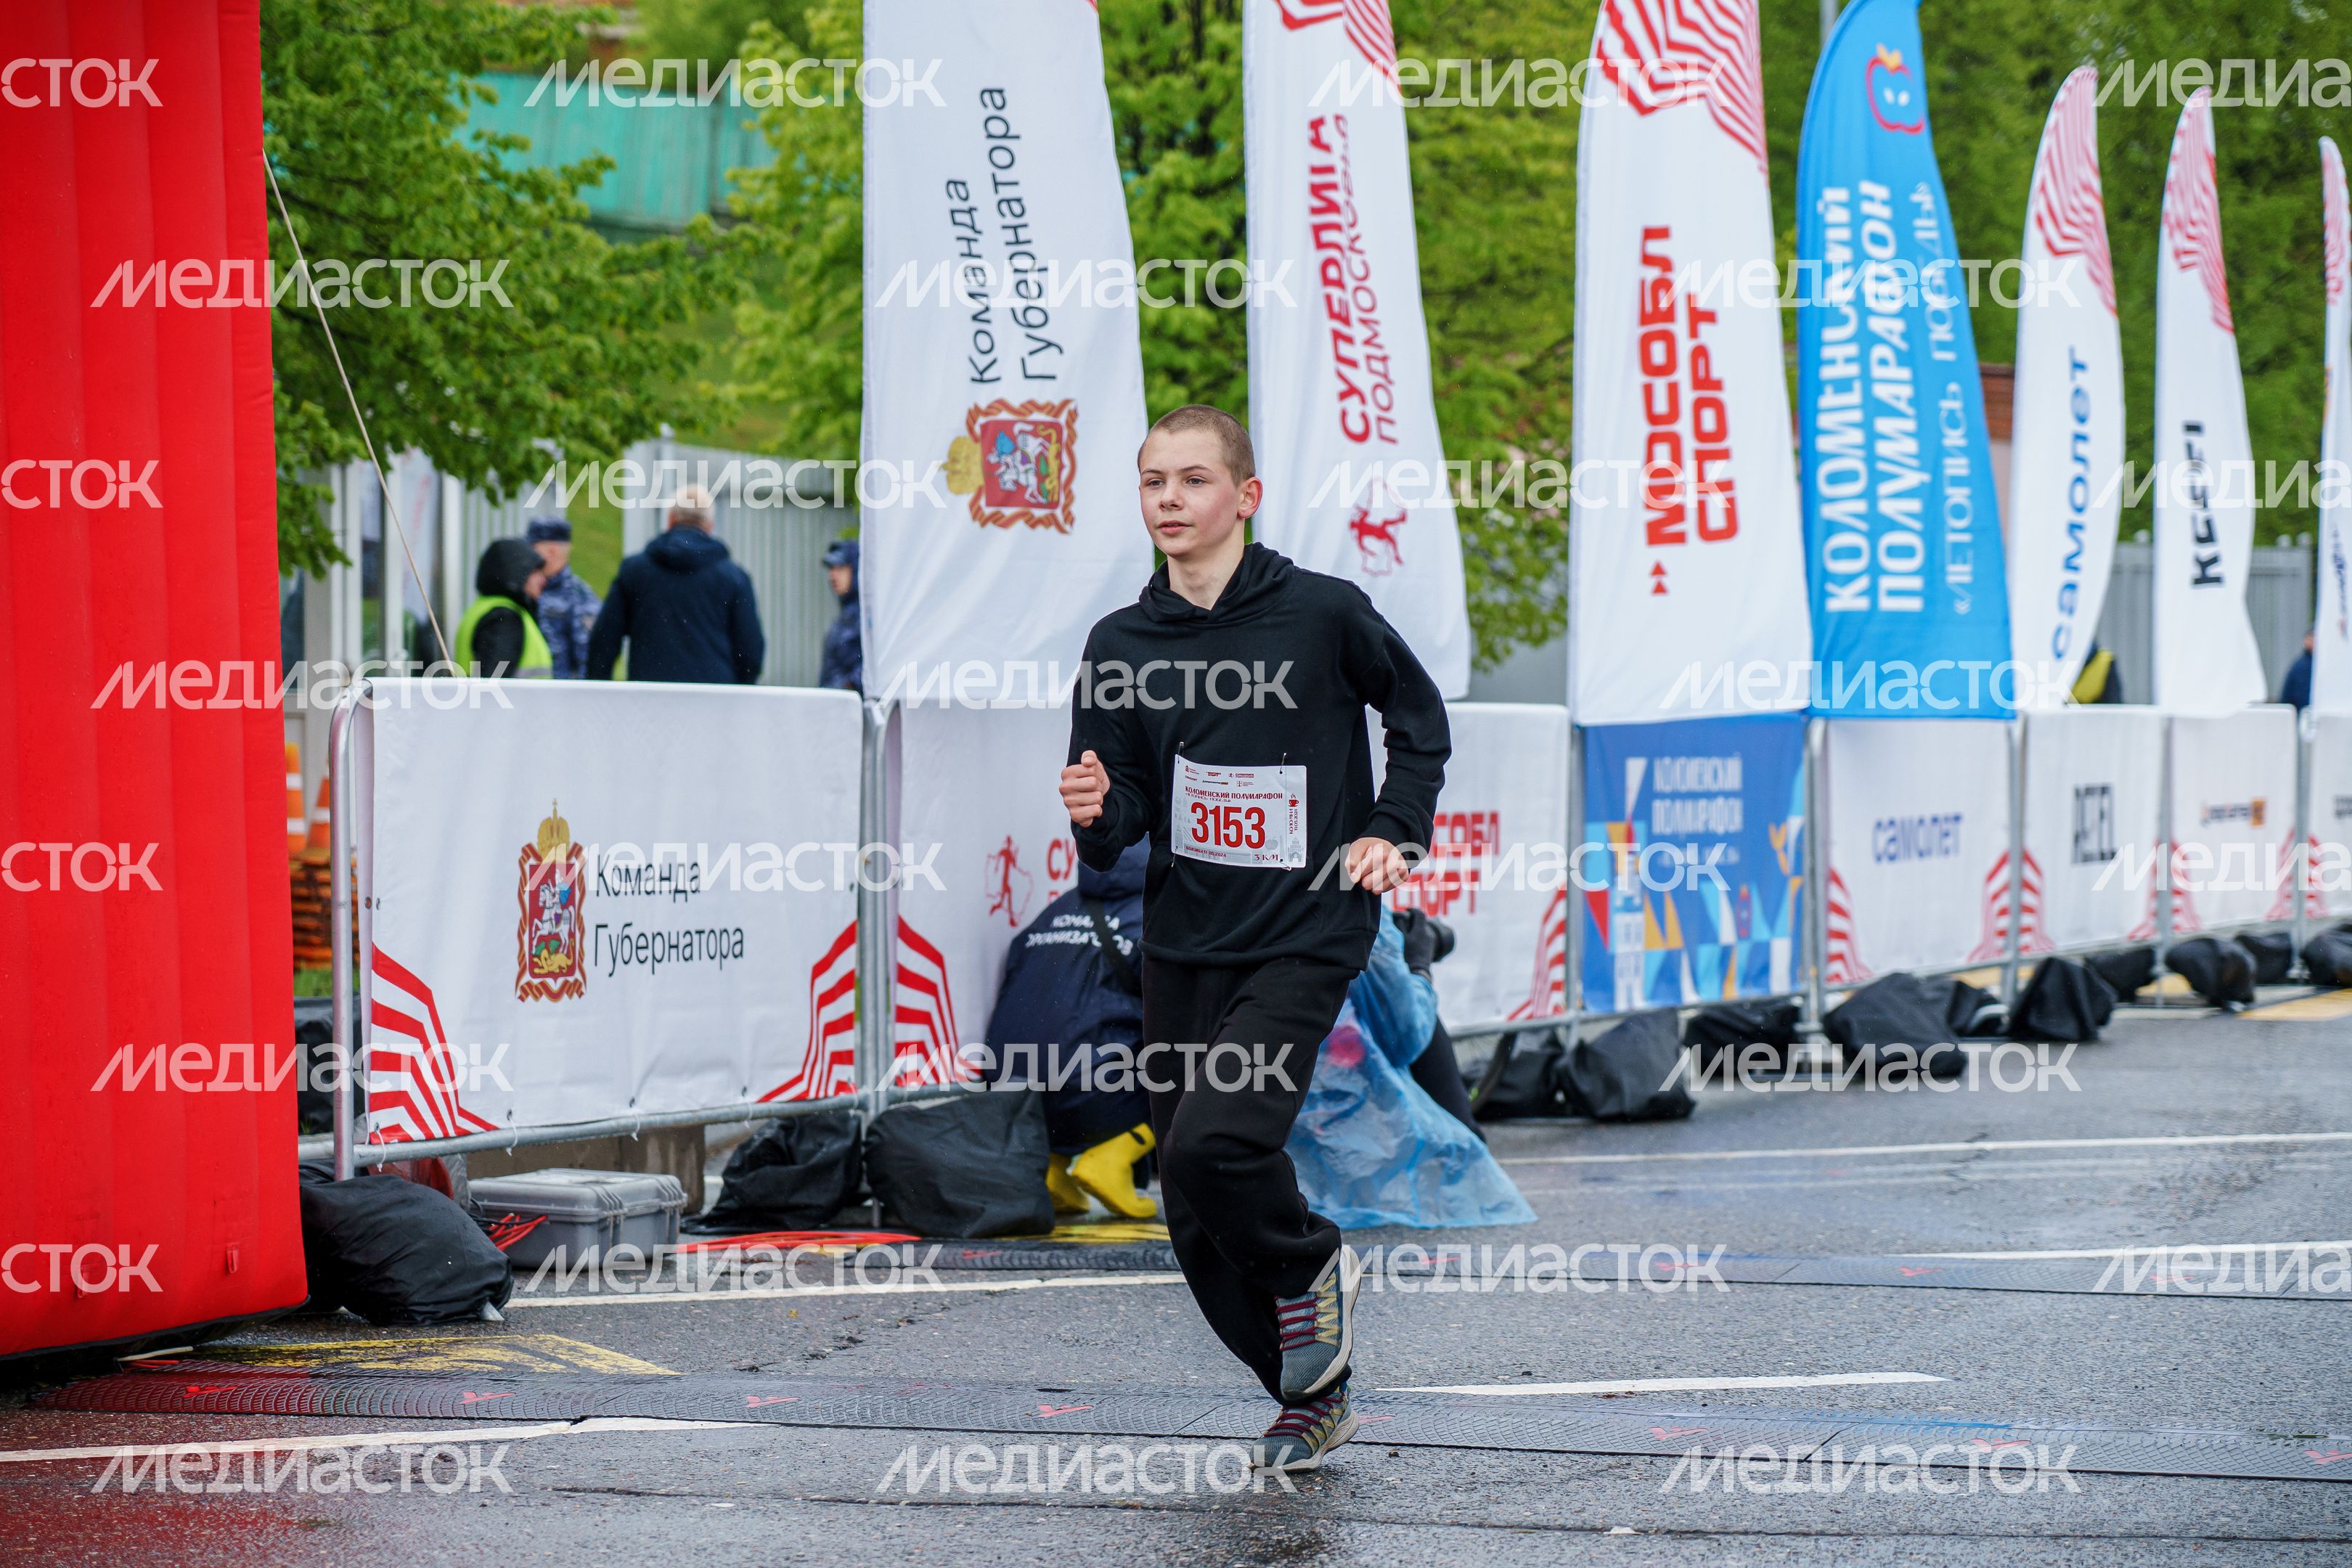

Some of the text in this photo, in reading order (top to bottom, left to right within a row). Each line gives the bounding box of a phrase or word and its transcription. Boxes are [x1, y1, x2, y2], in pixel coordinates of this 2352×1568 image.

[979, 86, 1063, 382] Губернатора
[945, 178, 1002, 385] Команда
[1638, 225, 1688, 547] МОСОБЛ
[1686, 292, 1739, 543] СПОРТ
[1185, 786, 1230, 799] КОЛОМЕНСКИЙ
[1191, 802, 1265, 849] 3153
[1433, 811, 1499, 857] СОБЛ
[596, 854, 701, 902] Команда
[594, 923, 743, 977] Губернатора
